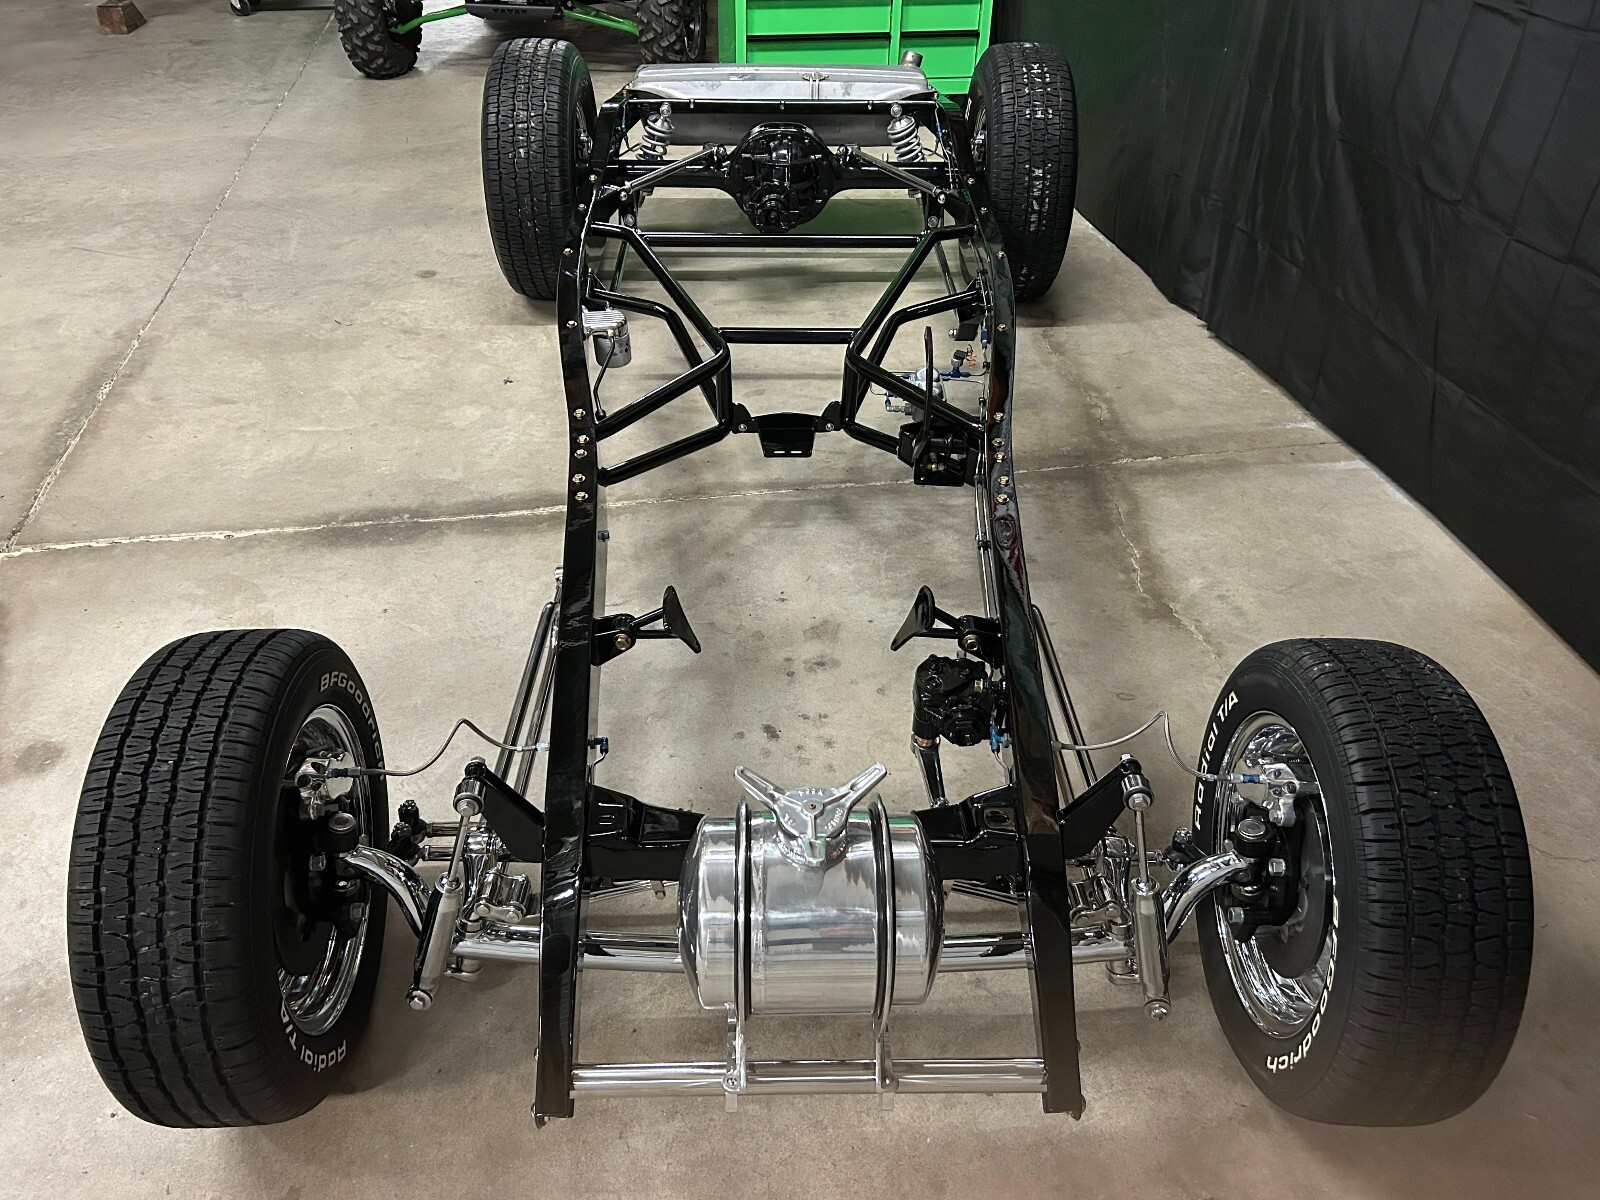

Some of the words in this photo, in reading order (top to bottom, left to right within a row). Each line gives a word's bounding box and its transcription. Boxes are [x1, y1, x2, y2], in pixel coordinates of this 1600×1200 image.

[1194, 722, 1219, 830] Radial
[1216, 690, 1239, 722] T/A
[1266, 894, 1339, 1073] BFGoodrich
[301, 1039, 347, 1072] Radial
